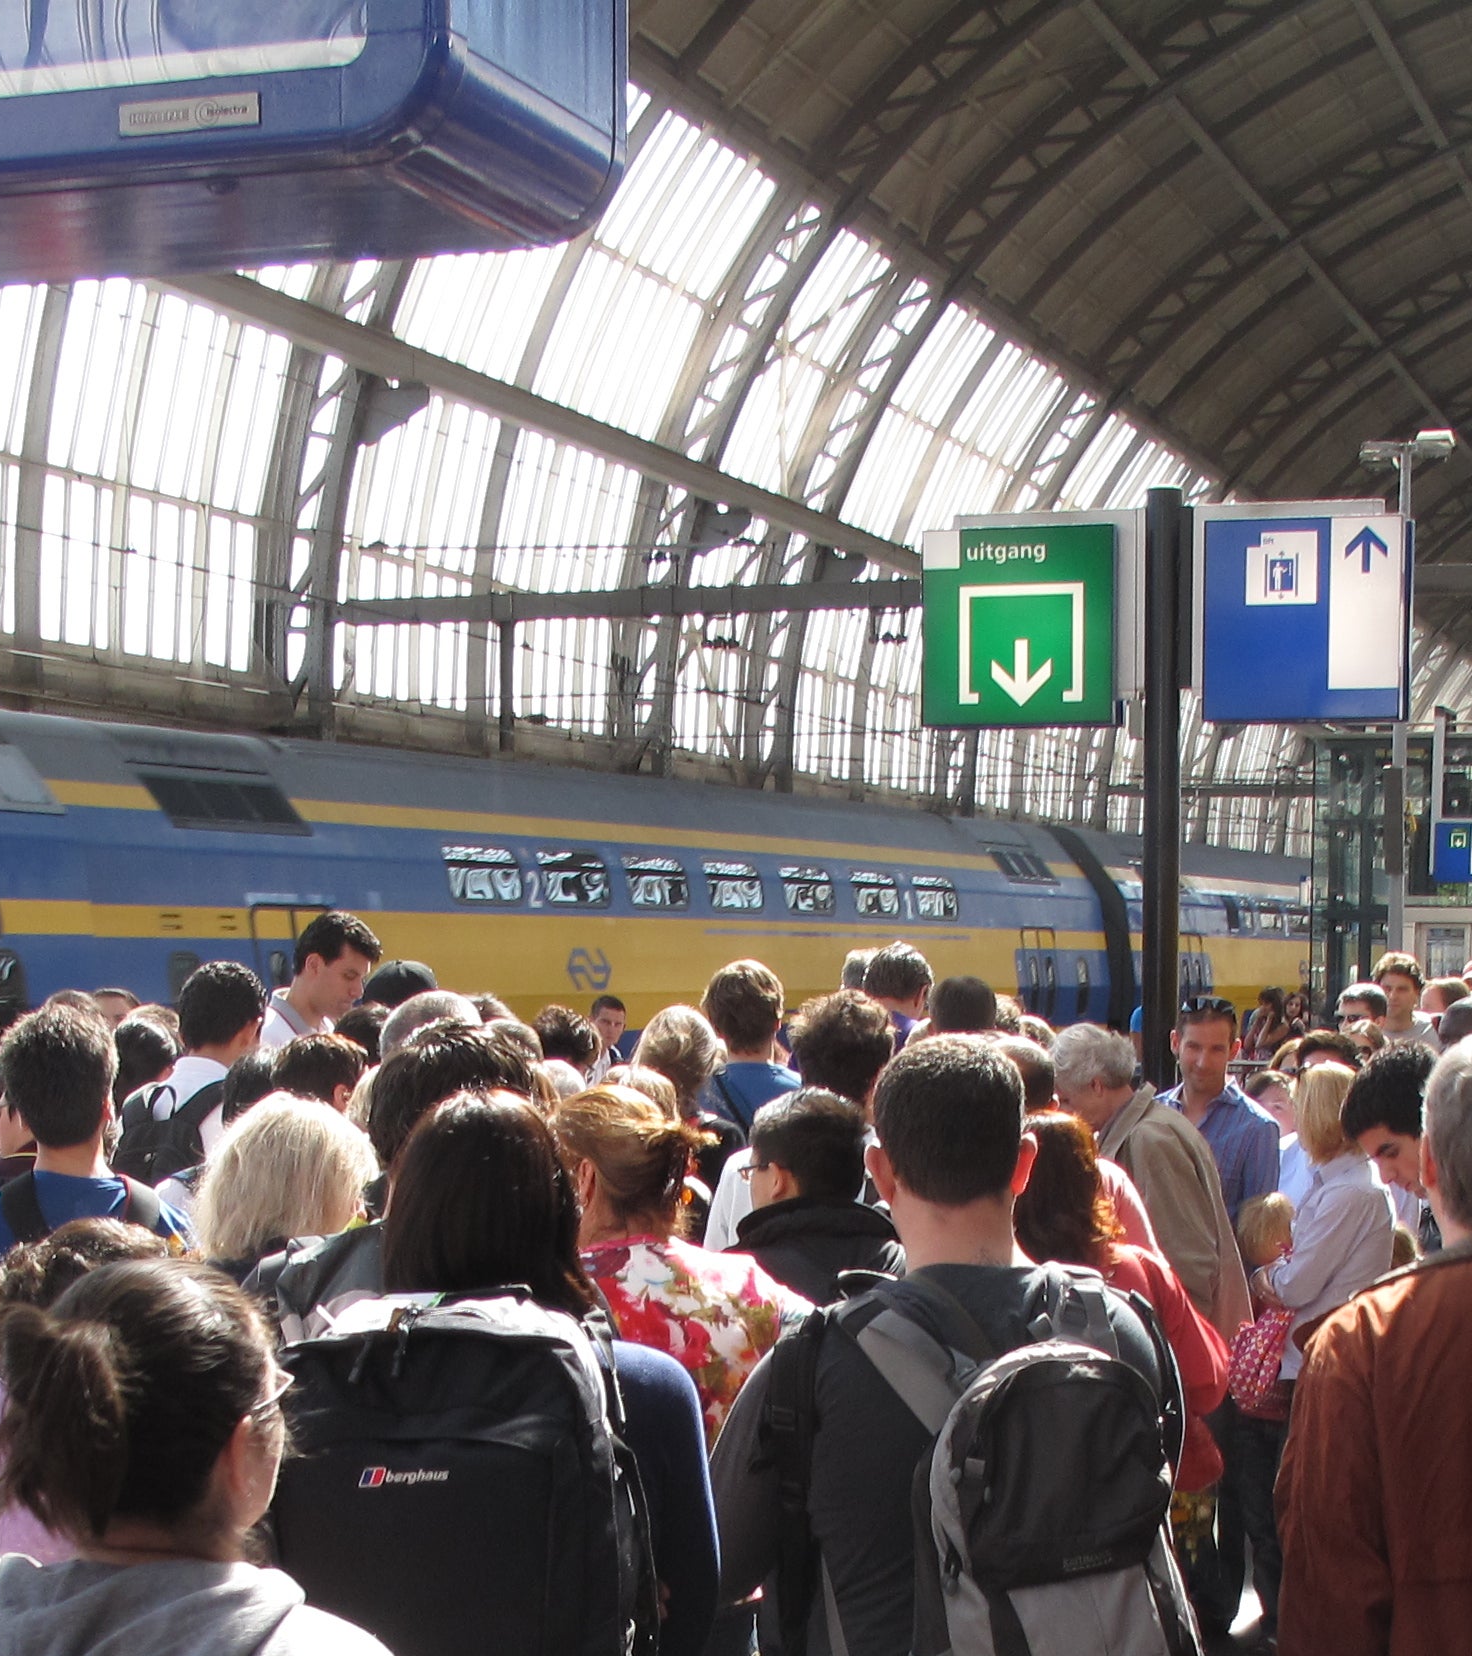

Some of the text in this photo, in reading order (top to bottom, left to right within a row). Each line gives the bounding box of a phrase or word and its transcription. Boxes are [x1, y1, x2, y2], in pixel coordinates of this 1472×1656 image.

[966, 542, 1046, 565] uitgang
[526, 870, 544, 909] 2
[385, 1469, 449, 1485] berghaus
